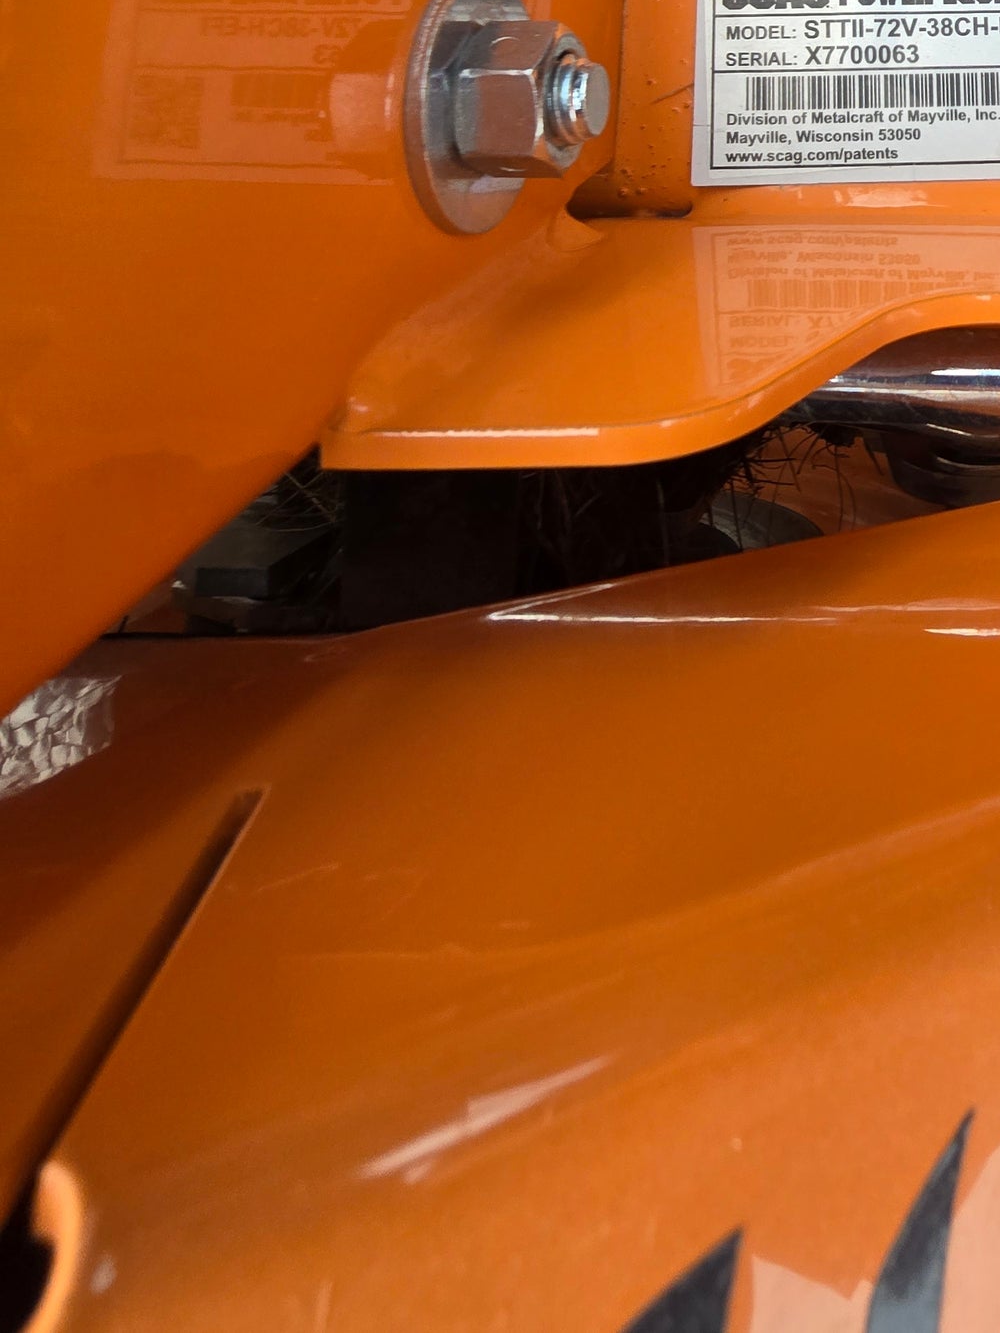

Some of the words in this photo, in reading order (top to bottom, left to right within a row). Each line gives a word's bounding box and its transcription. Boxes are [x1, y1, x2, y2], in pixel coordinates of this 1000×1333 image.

[726, 26, 796, 40] MODEL:
[725, 51, 797, 66] SERIAL:
[805, 45, 919, 65] X7700063
[726, 113, 787, 125] Division
[792, 112, 807, 124] of
[811, 111, 884, 124] Metalcraft
[888, 110, 903, 122] of
[908, 109, 970, 124] Mayville,
[726, 131, 791, 146] Mayville,
[796, 129, 873, 143] Wisconsin
[878, 128, 921, 141] 53050
[725, 148, 898, 163] www.scag.com/patents
